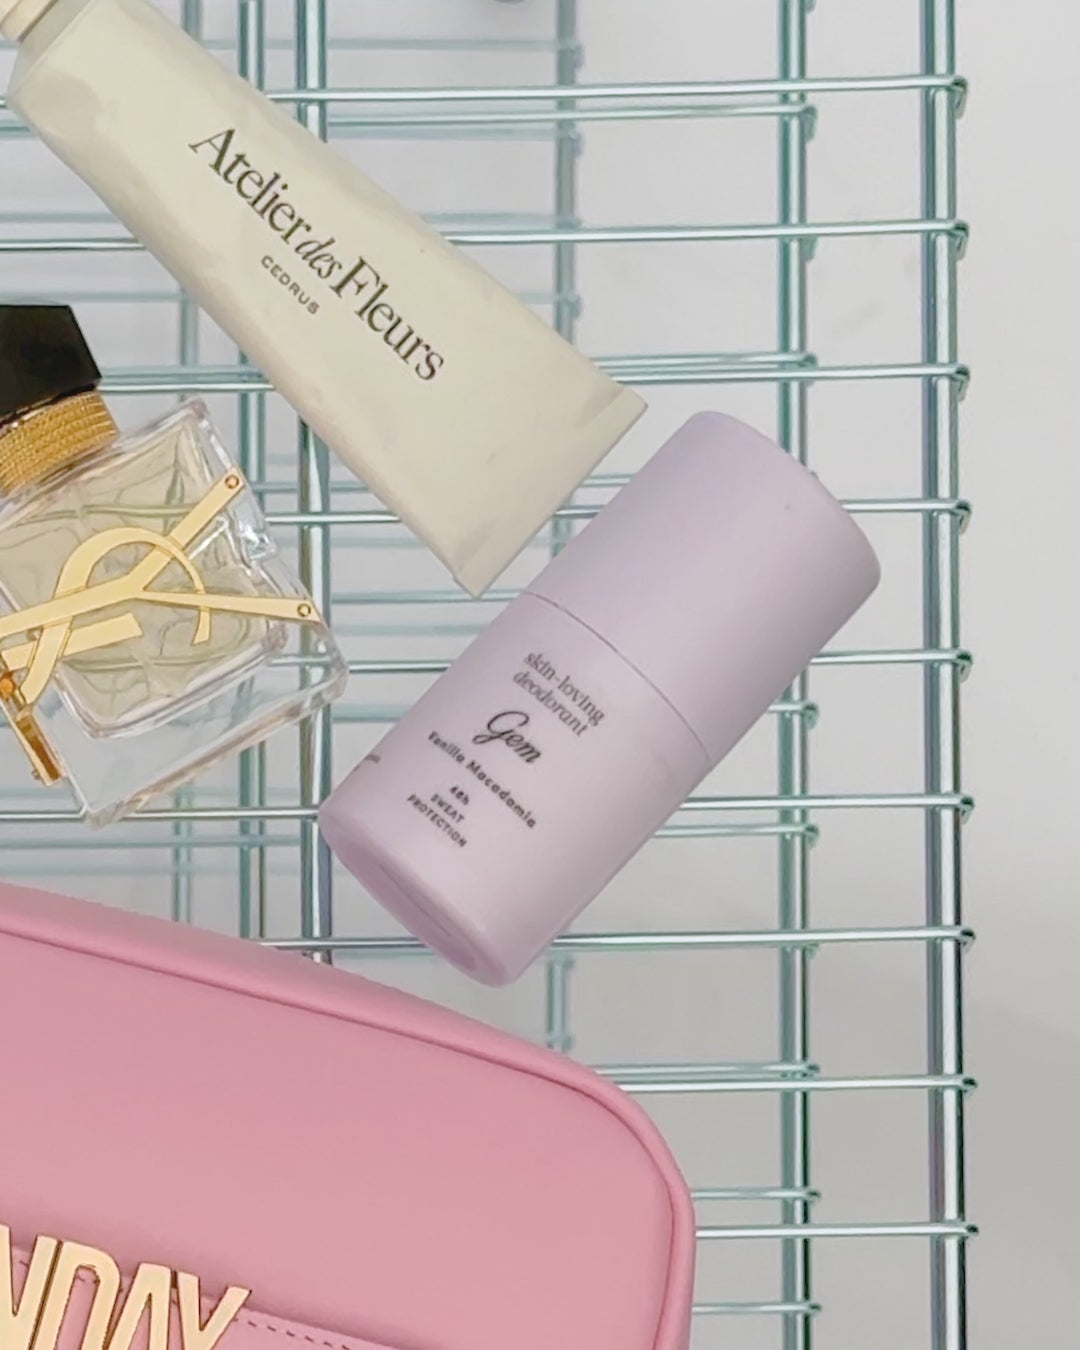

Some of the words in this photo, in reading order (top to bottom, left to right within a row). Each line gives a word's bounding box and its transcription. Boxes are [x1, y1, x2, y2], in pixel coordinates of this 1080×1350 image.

[188, 128, 312, 245] Atelier
[294, 238, 342, 279] des
[330, 256, 445, 381] Fleurs
[261, 255, 320, 315] CEDRUS
[512, 670, 591, 738] deodorant
[524, 651, 606, 727] skin-loving
[472, 710, 542, 764] Gem
[428, 731, 465, 764] Vanilla
[466, 759, 537, 829] Macadamia
[430, 793, 466, 824] SWEAT
[407, 794, 468, 848] PROTECTION
